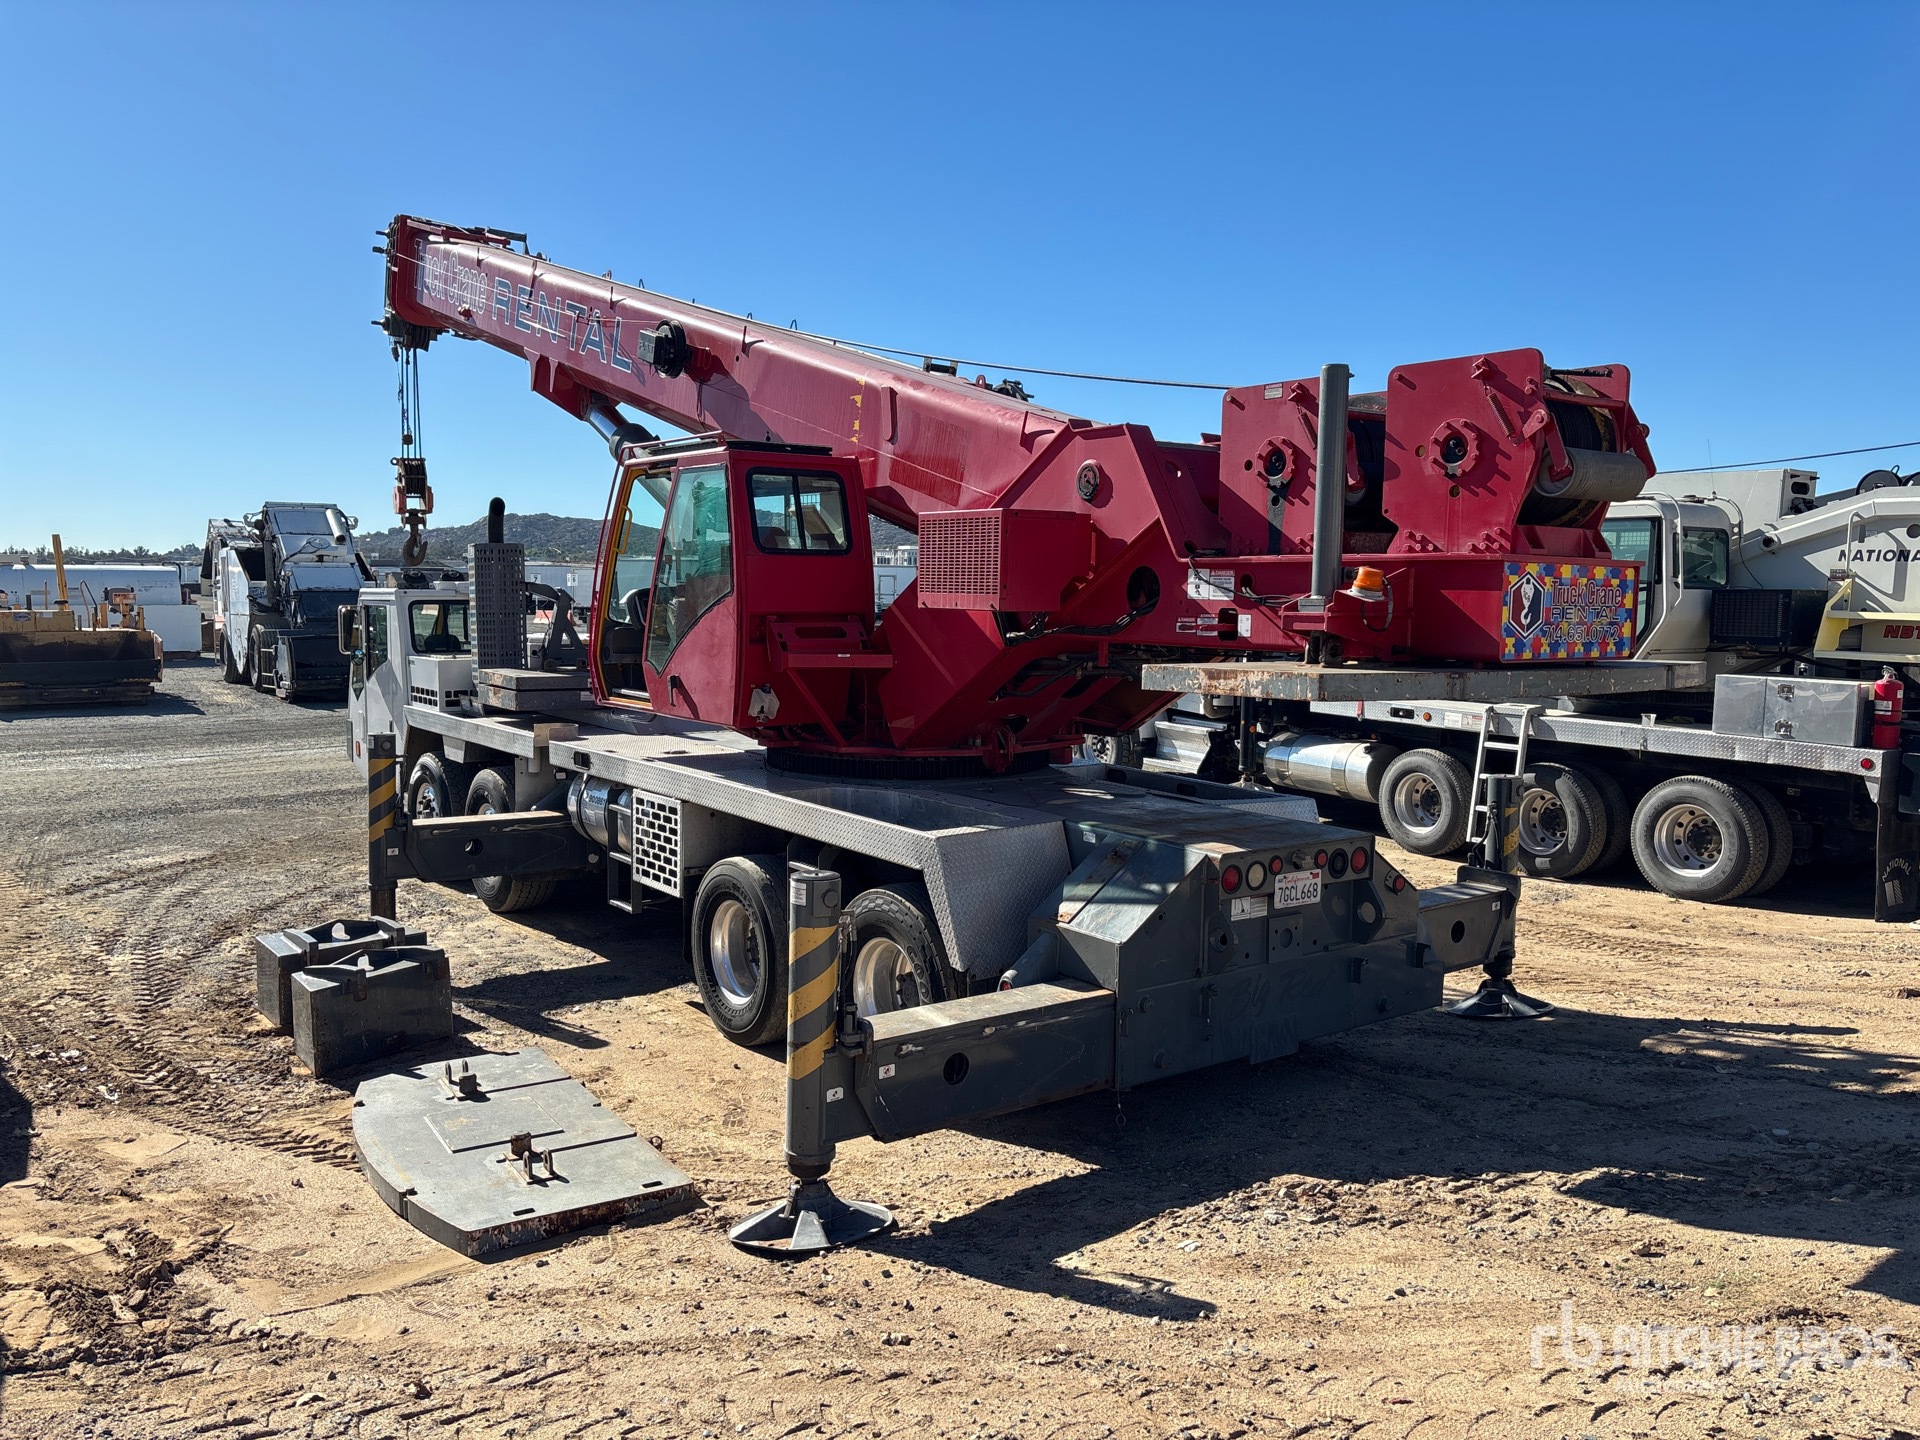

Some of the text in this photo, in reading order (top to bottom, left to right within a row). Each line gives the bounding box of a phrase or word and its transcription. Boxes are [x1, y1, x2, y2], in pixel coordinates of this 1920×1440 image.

[414, 239, 632, 373] Truck Crane RENTAL
[1551, 579, 1622, 607] Truck Crane
[1550, 606, 1621, 622] RENTAL
[1543, 624, 1620, 643] 714.651.0772
[1284, 875, 1312, 885] California
[1881, 857, 1912, 882] NATIONAL
[1278, 882, 1319, 904] 7GCL668
